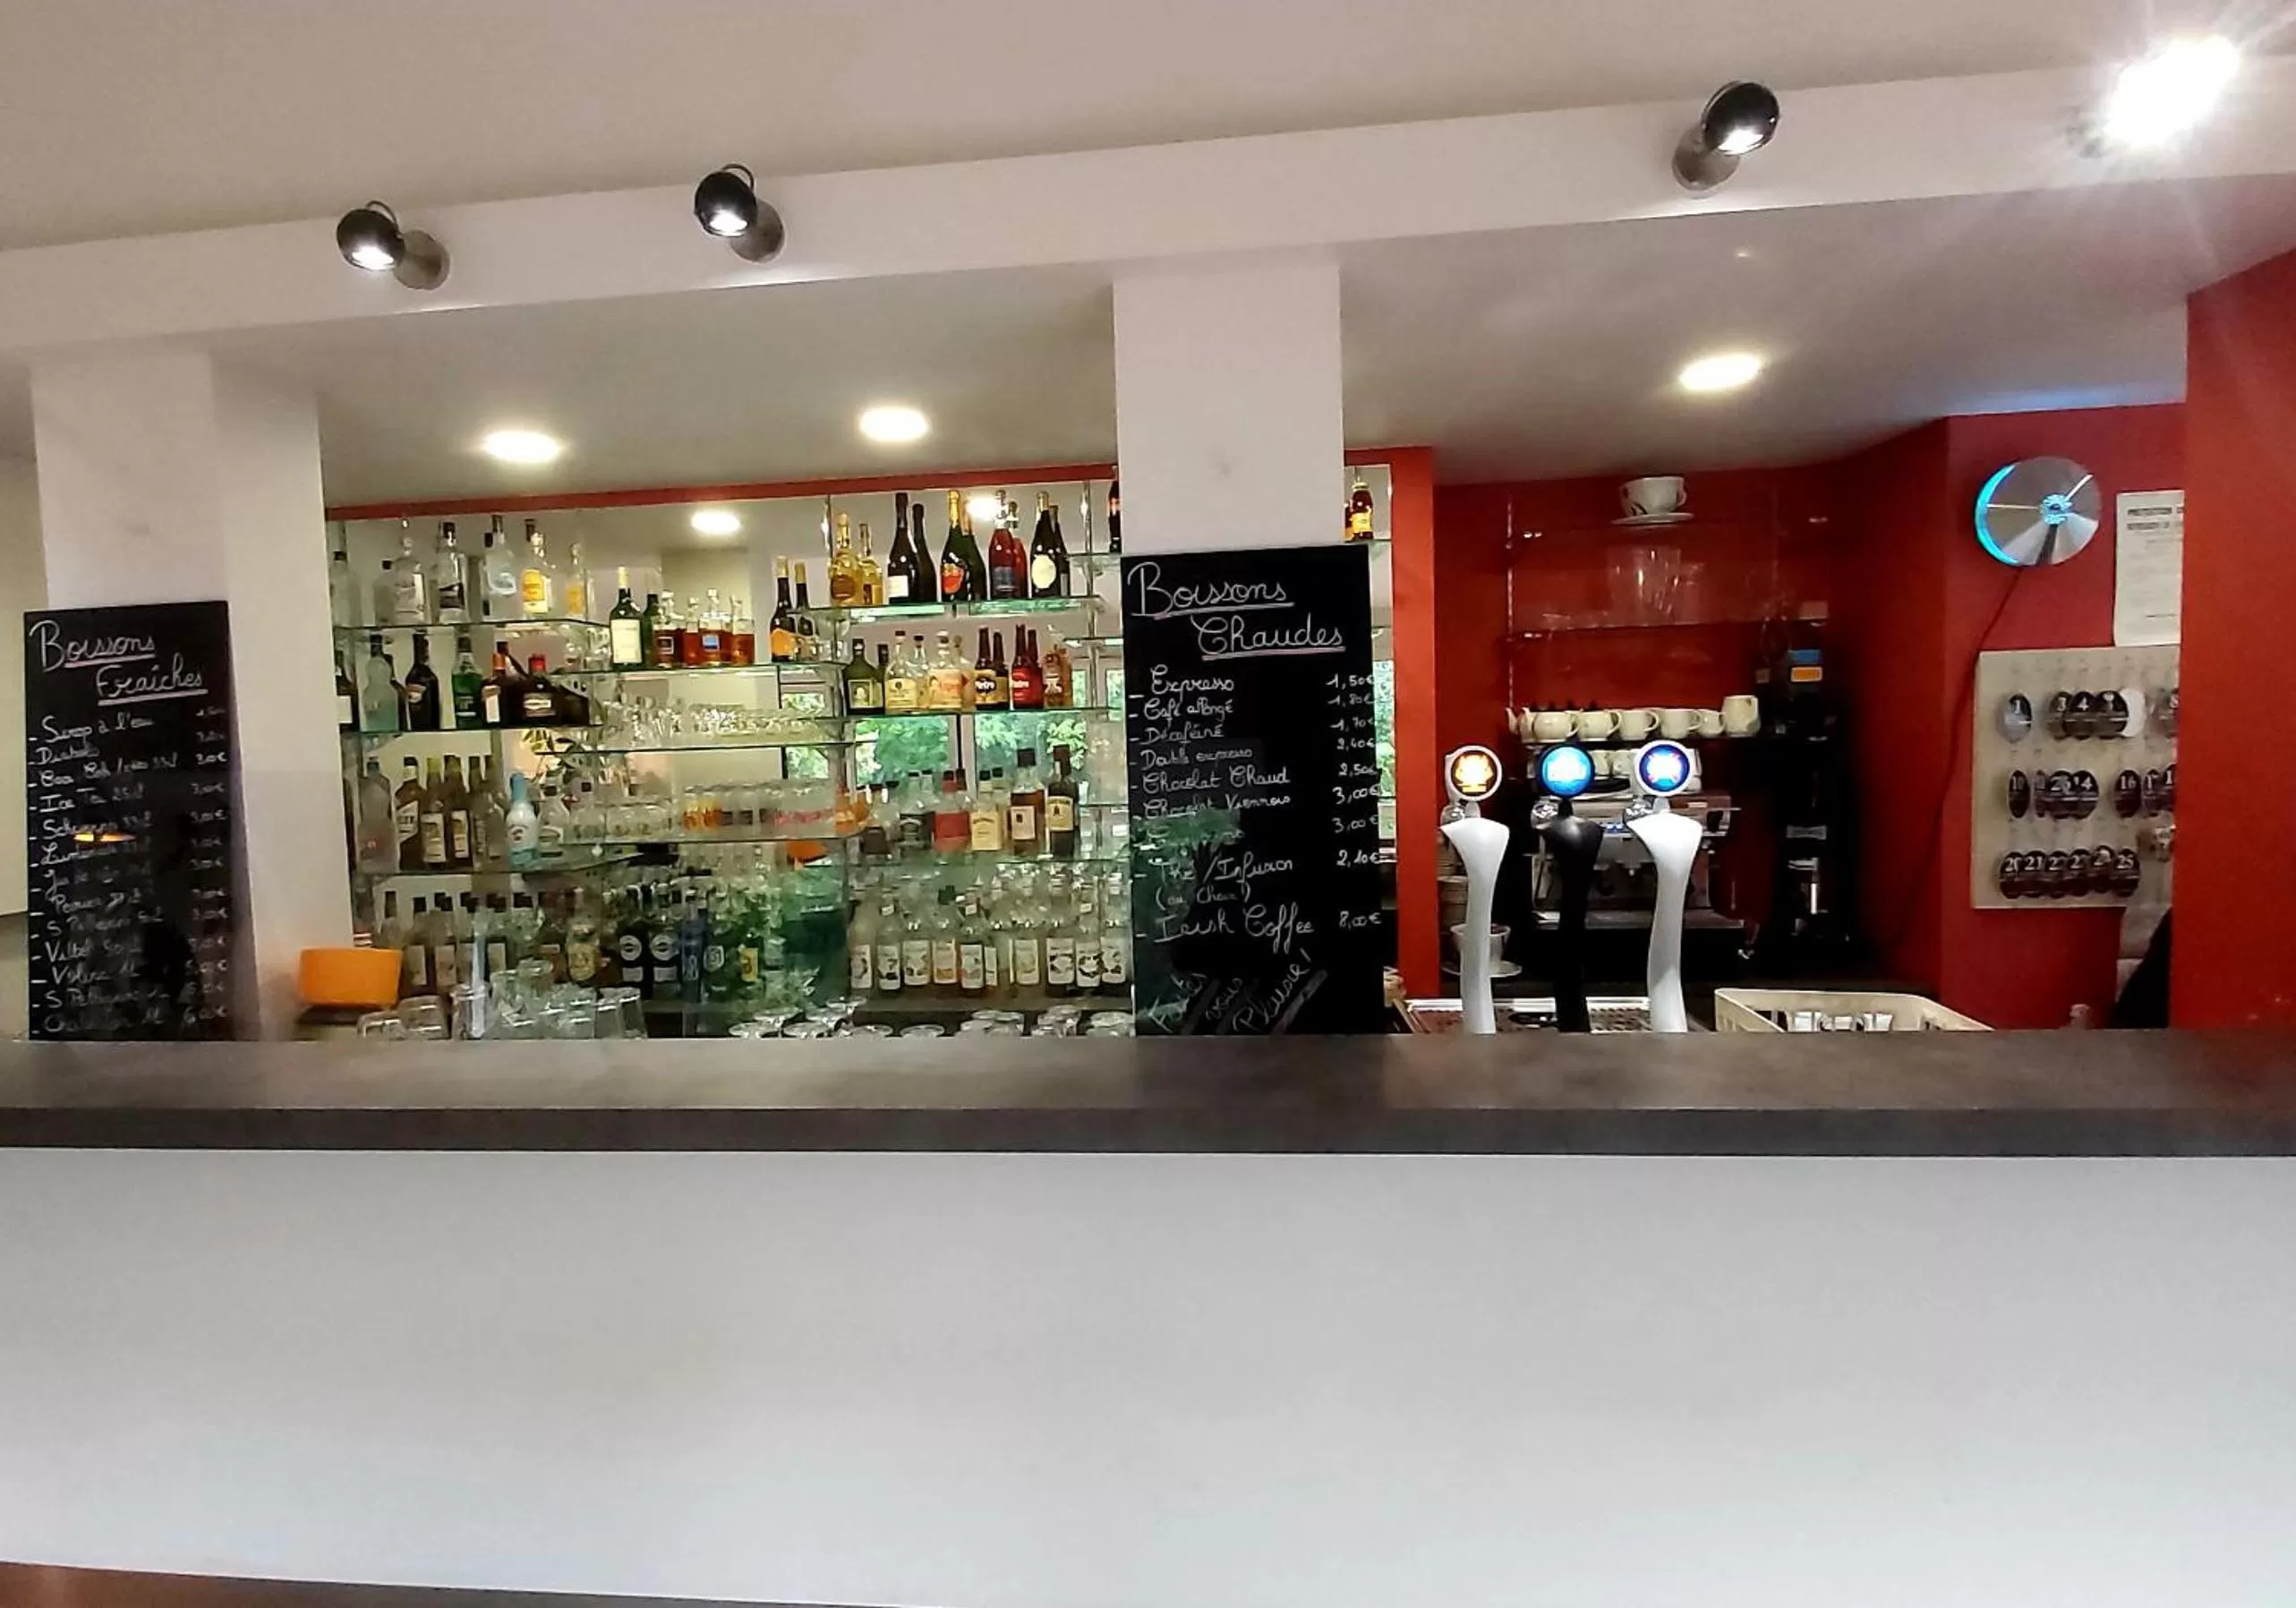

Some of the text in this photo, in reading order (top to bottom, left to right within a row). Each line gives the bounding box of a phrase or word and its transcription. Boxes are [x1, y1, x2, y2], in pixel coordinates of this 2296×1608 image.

[1128, 561, 1287, 616] Boissons
[29, 620, 156, 671] Boissons
[1191, 612, 1344, 655] Chaudes
[1228, 764, 1292, 787] Chaud
[1242, 901, 1314, 954] Coffee
